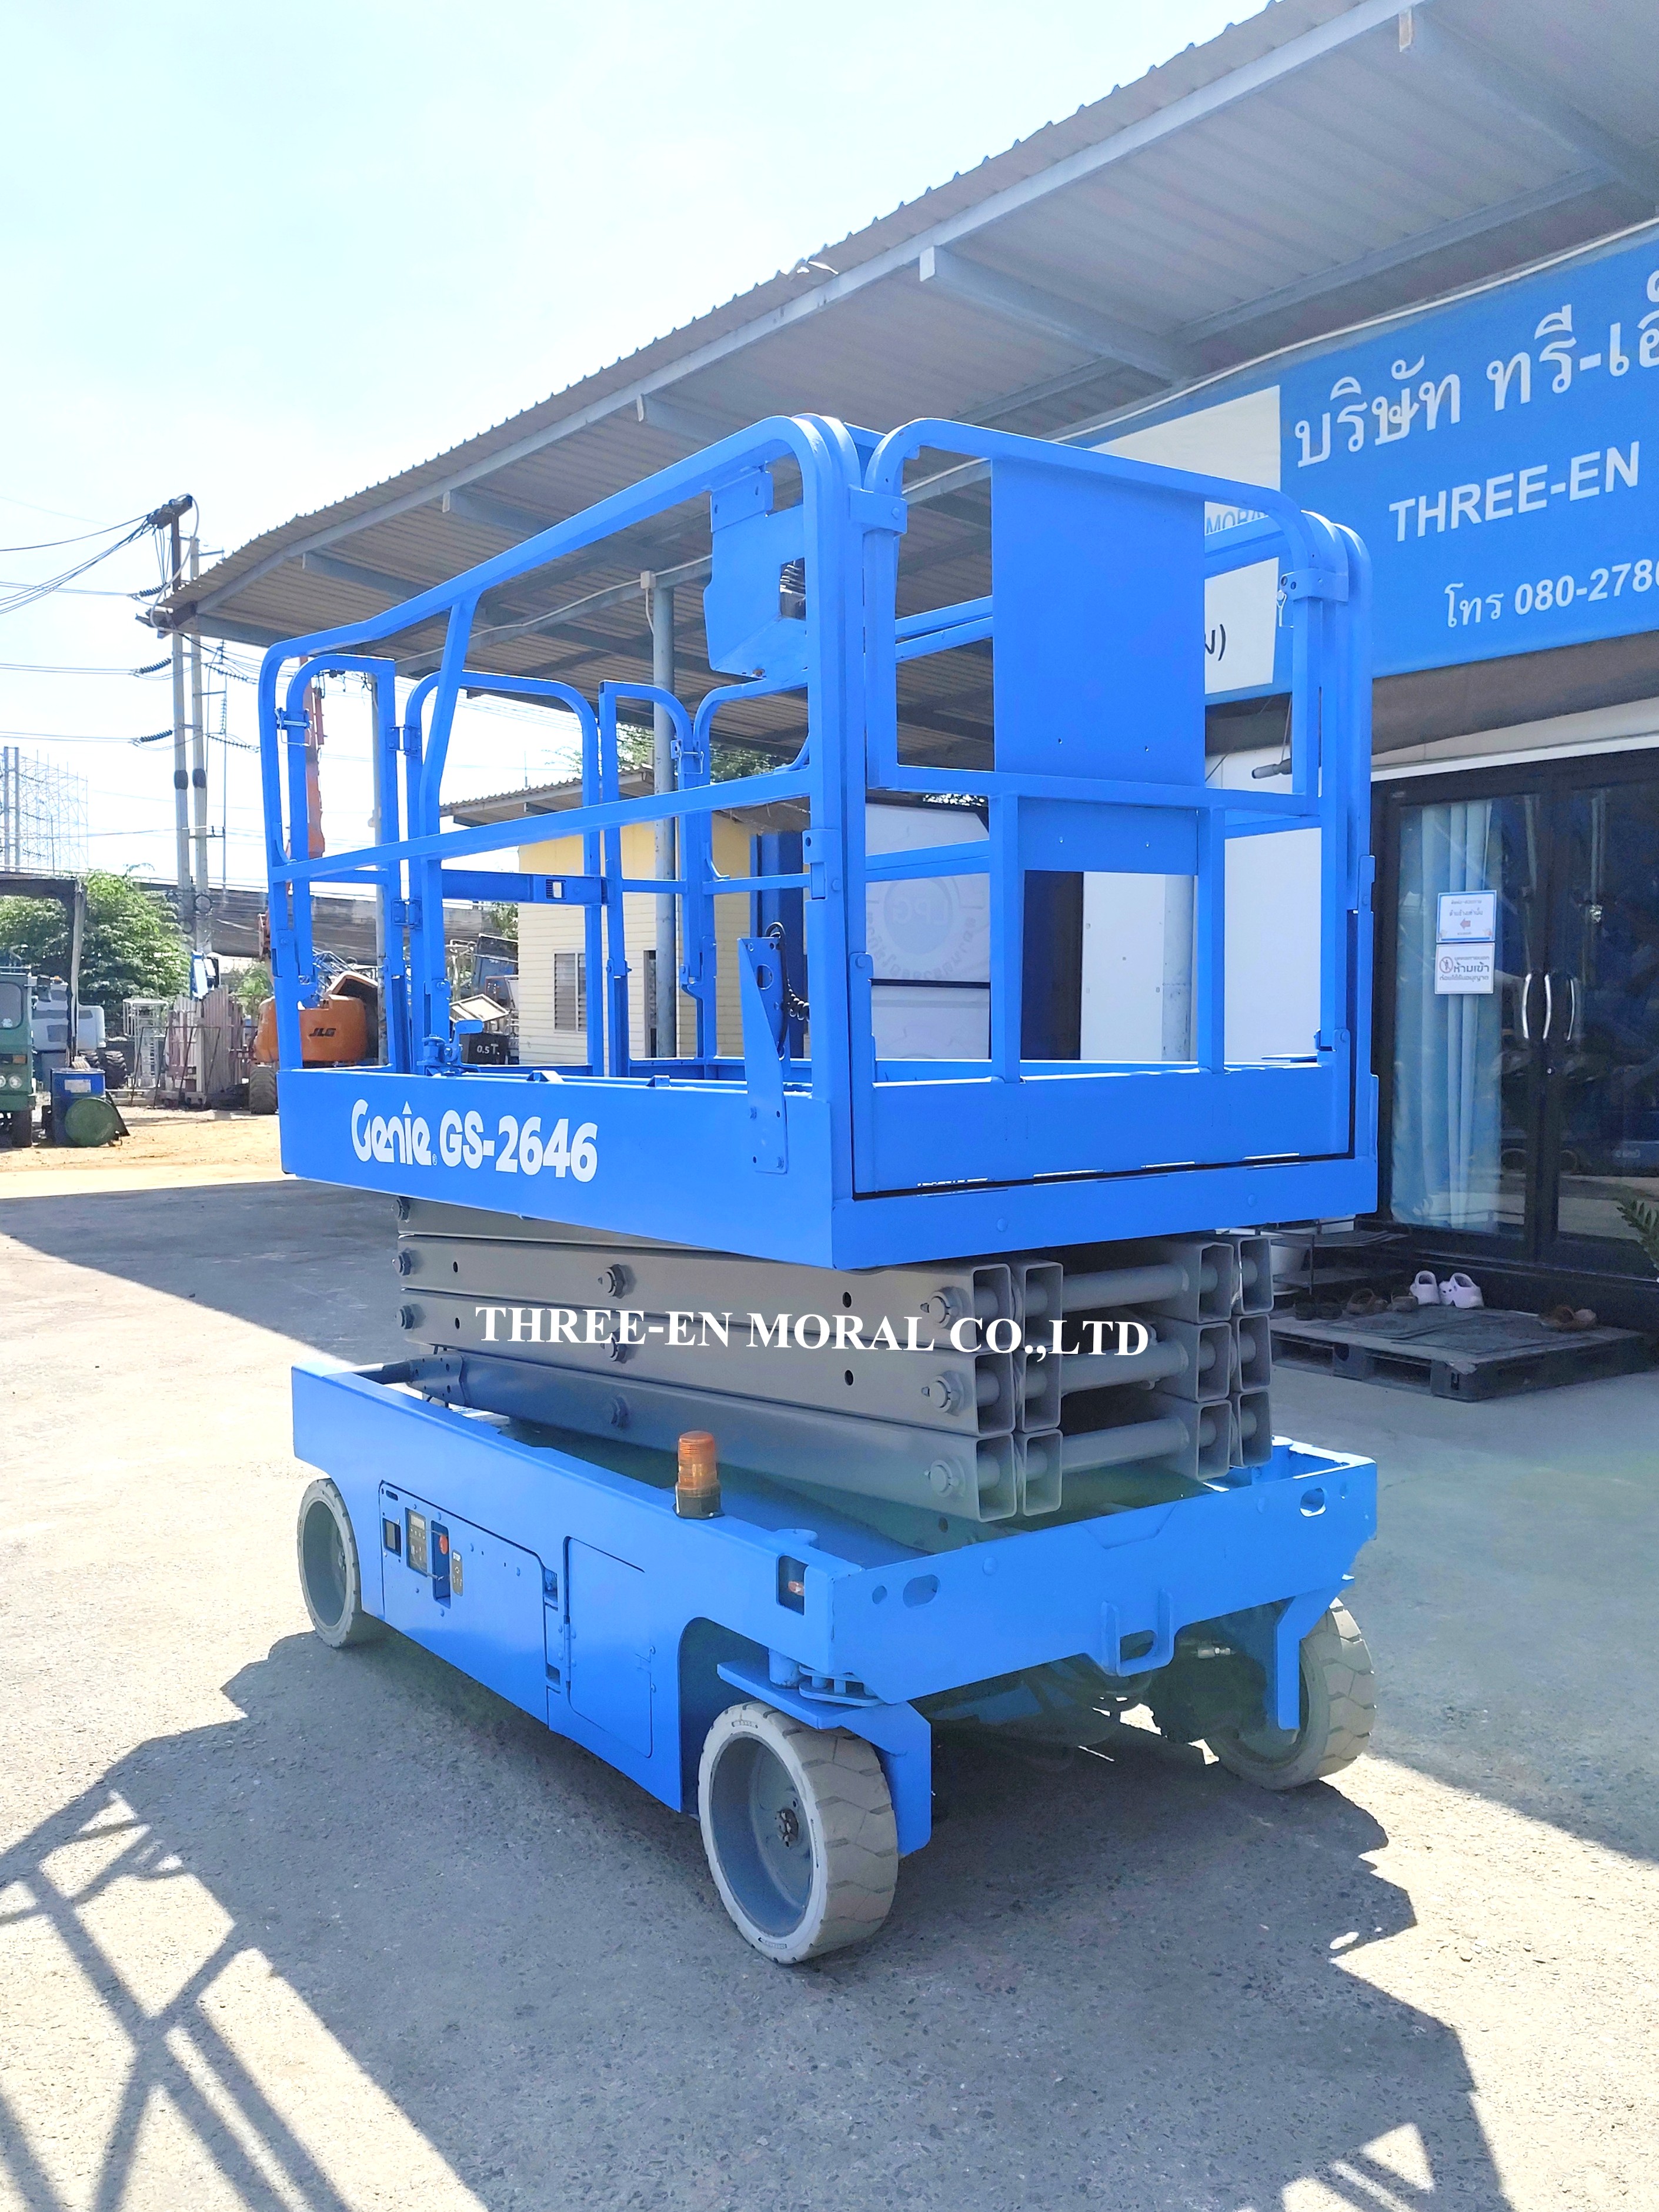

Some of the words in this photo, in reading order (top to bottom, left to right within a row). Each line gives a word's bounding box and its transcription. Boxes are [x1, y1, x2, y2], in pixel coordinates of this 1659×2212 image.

[1295, 355, 1460, 468] บริษัท
[1389, 441, 1640, 541] THREE-EN
[1445, 582, 1504, 628] โทร
[1514, 559, 1659, 615] 080-278
[1454, 962, 1489, 972] ห้ามเข้า
[309, 1027, 336, 1037] JLG
[352, 1099, 432, 1166] Genie
[439, 1109, 598, 1182] GS-2646
